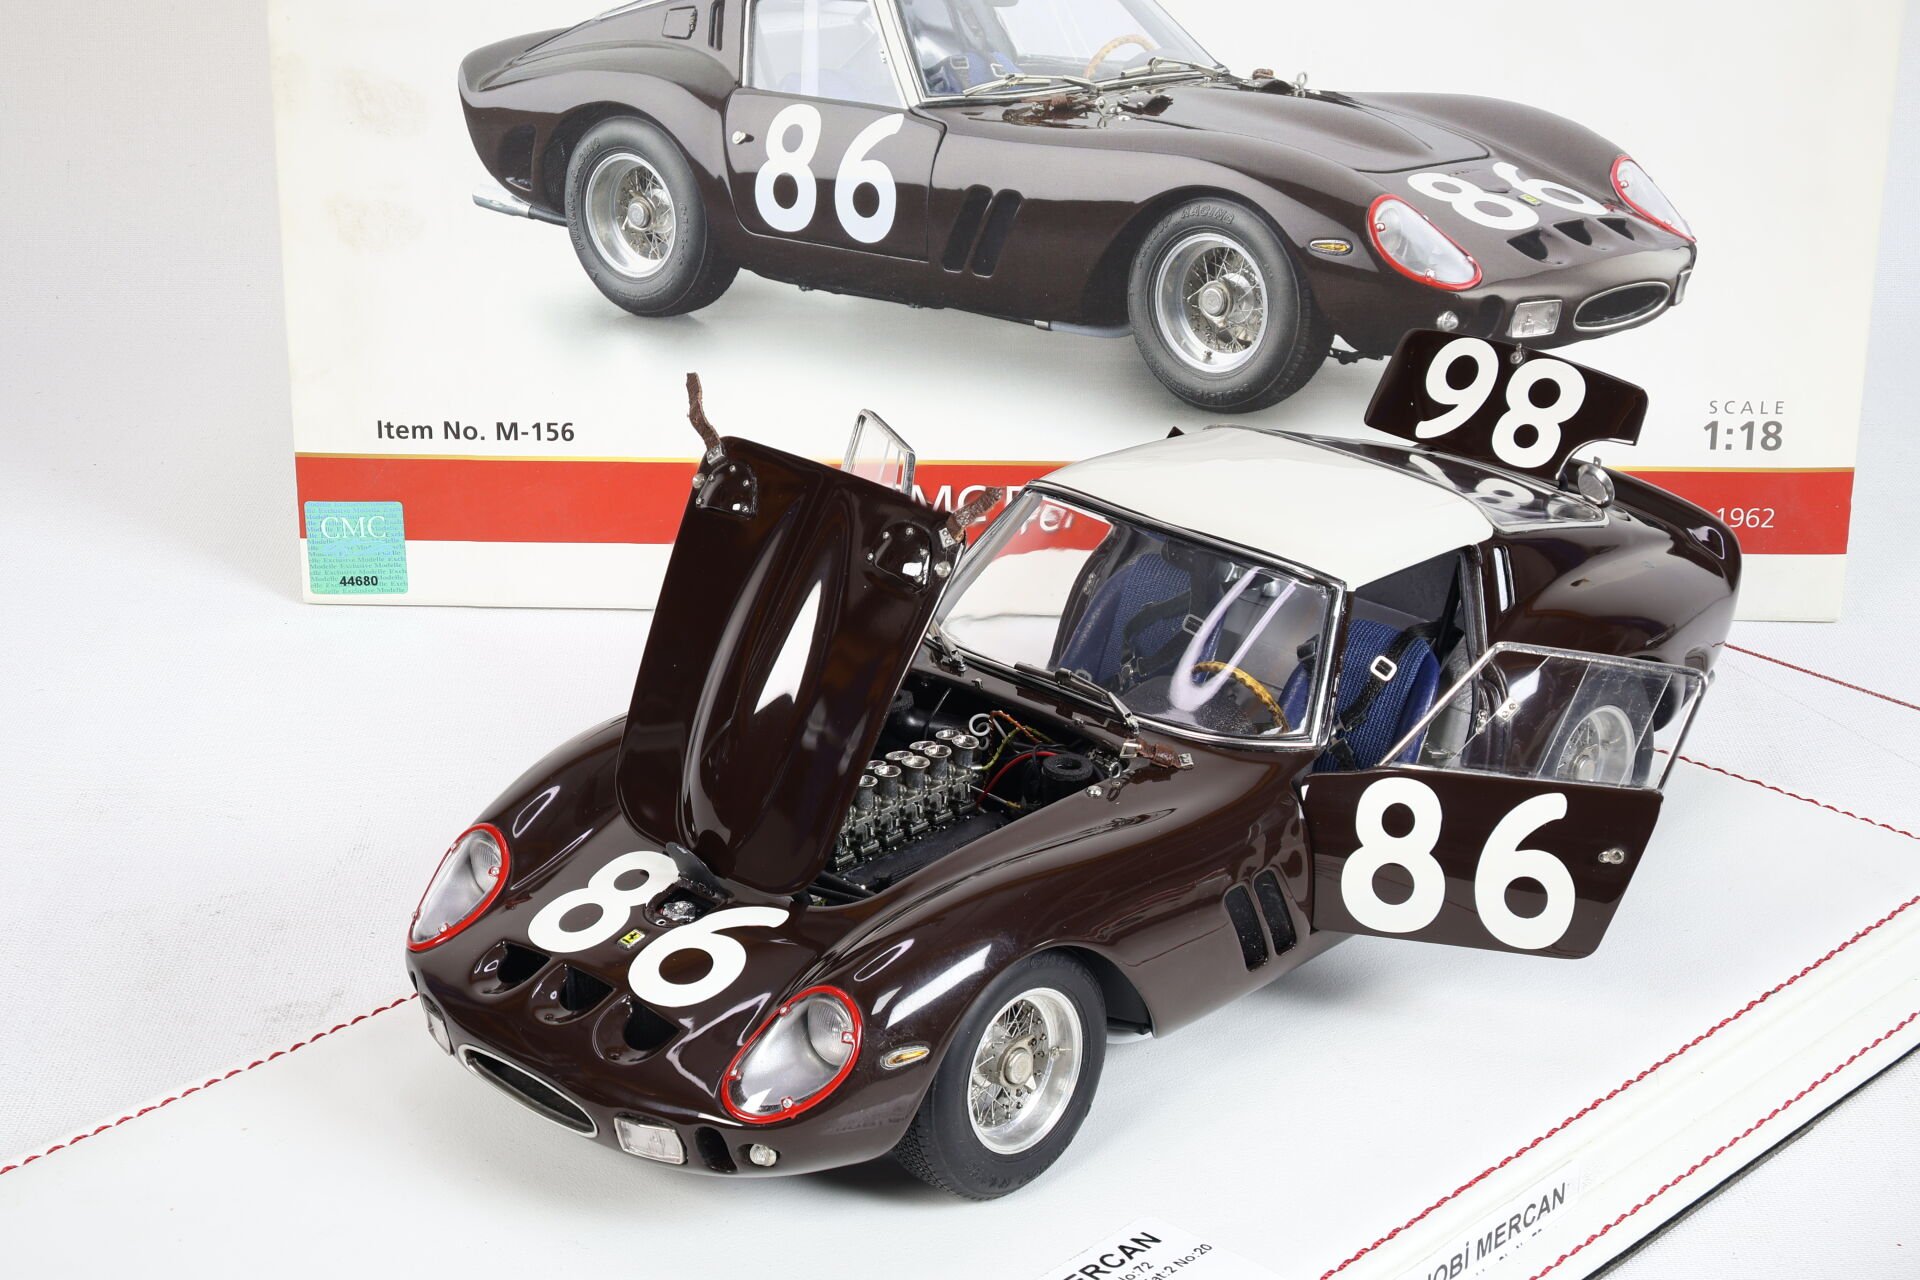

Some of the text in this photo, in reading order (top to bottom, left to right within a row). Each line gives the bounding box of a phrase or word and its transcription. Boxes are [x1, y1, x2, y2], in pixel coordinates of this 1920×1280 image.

[755, 103, 904, 244] 86
[1407, 162, 1608, 231] 86
[1709, 400, 1785, 415] SCALE
[377, 420, 575, 442] Item No. M-156
[1703, 420, 1783, 451] 1:18
[321, 515, 386, 539] CMC
[1716, 507, 1775, 529] 1962
[340, 576, 378, 587] 44680
[1341, 777, 1576, 950] 86
[528, 850, 790, 1008] 86
[1476, 1182, 1566, 1261] MERCAN
[1174, 1243, 1213, 1268] No:20
